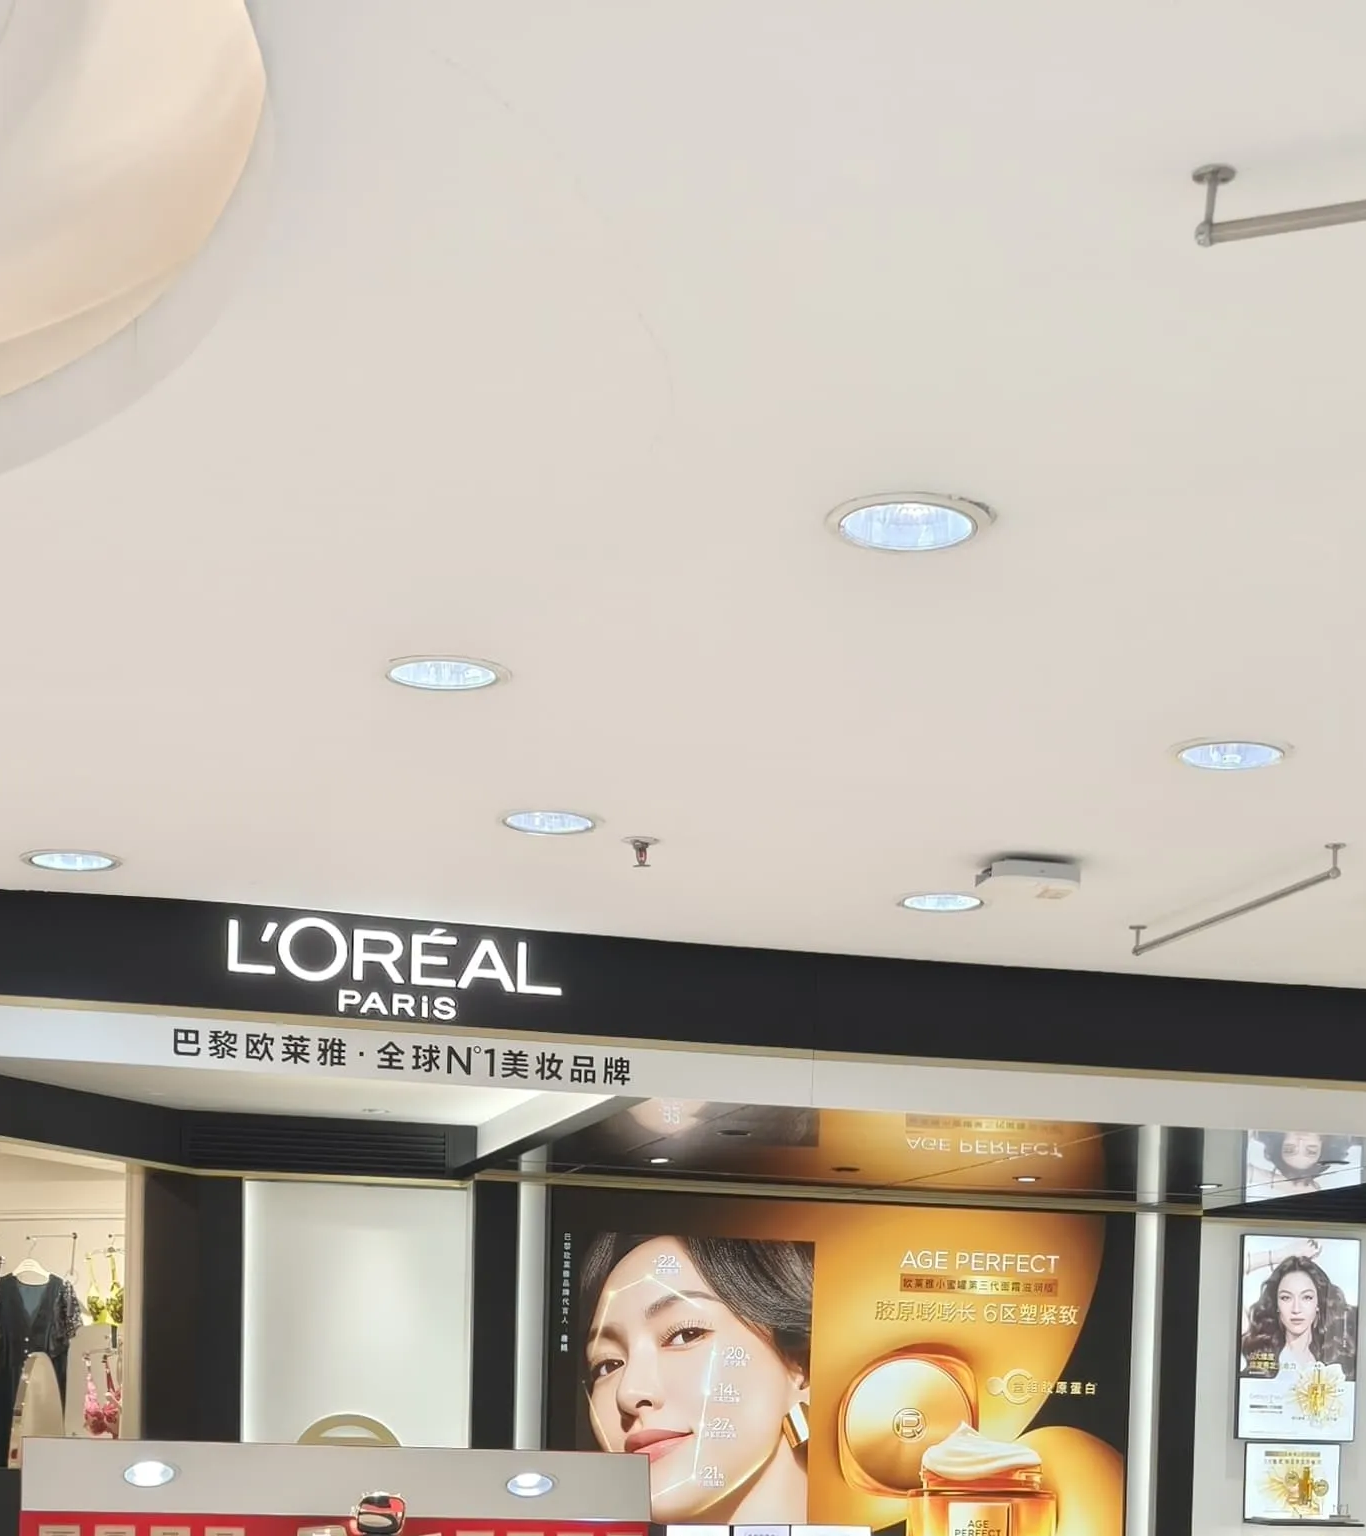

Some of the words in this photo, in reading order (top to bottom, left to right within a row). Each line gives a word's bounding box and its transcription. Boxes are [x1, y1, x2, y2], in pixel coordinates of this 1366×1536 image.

[226, 917, 562, 996] L'ORÉAL
[338, 989, 457, 1020] PARiS
[900, 1250, 949, 1270] AGE
[955, 1252, 1060, 1274] PERFECT
[967, 1519, 990, 1529] AGE
